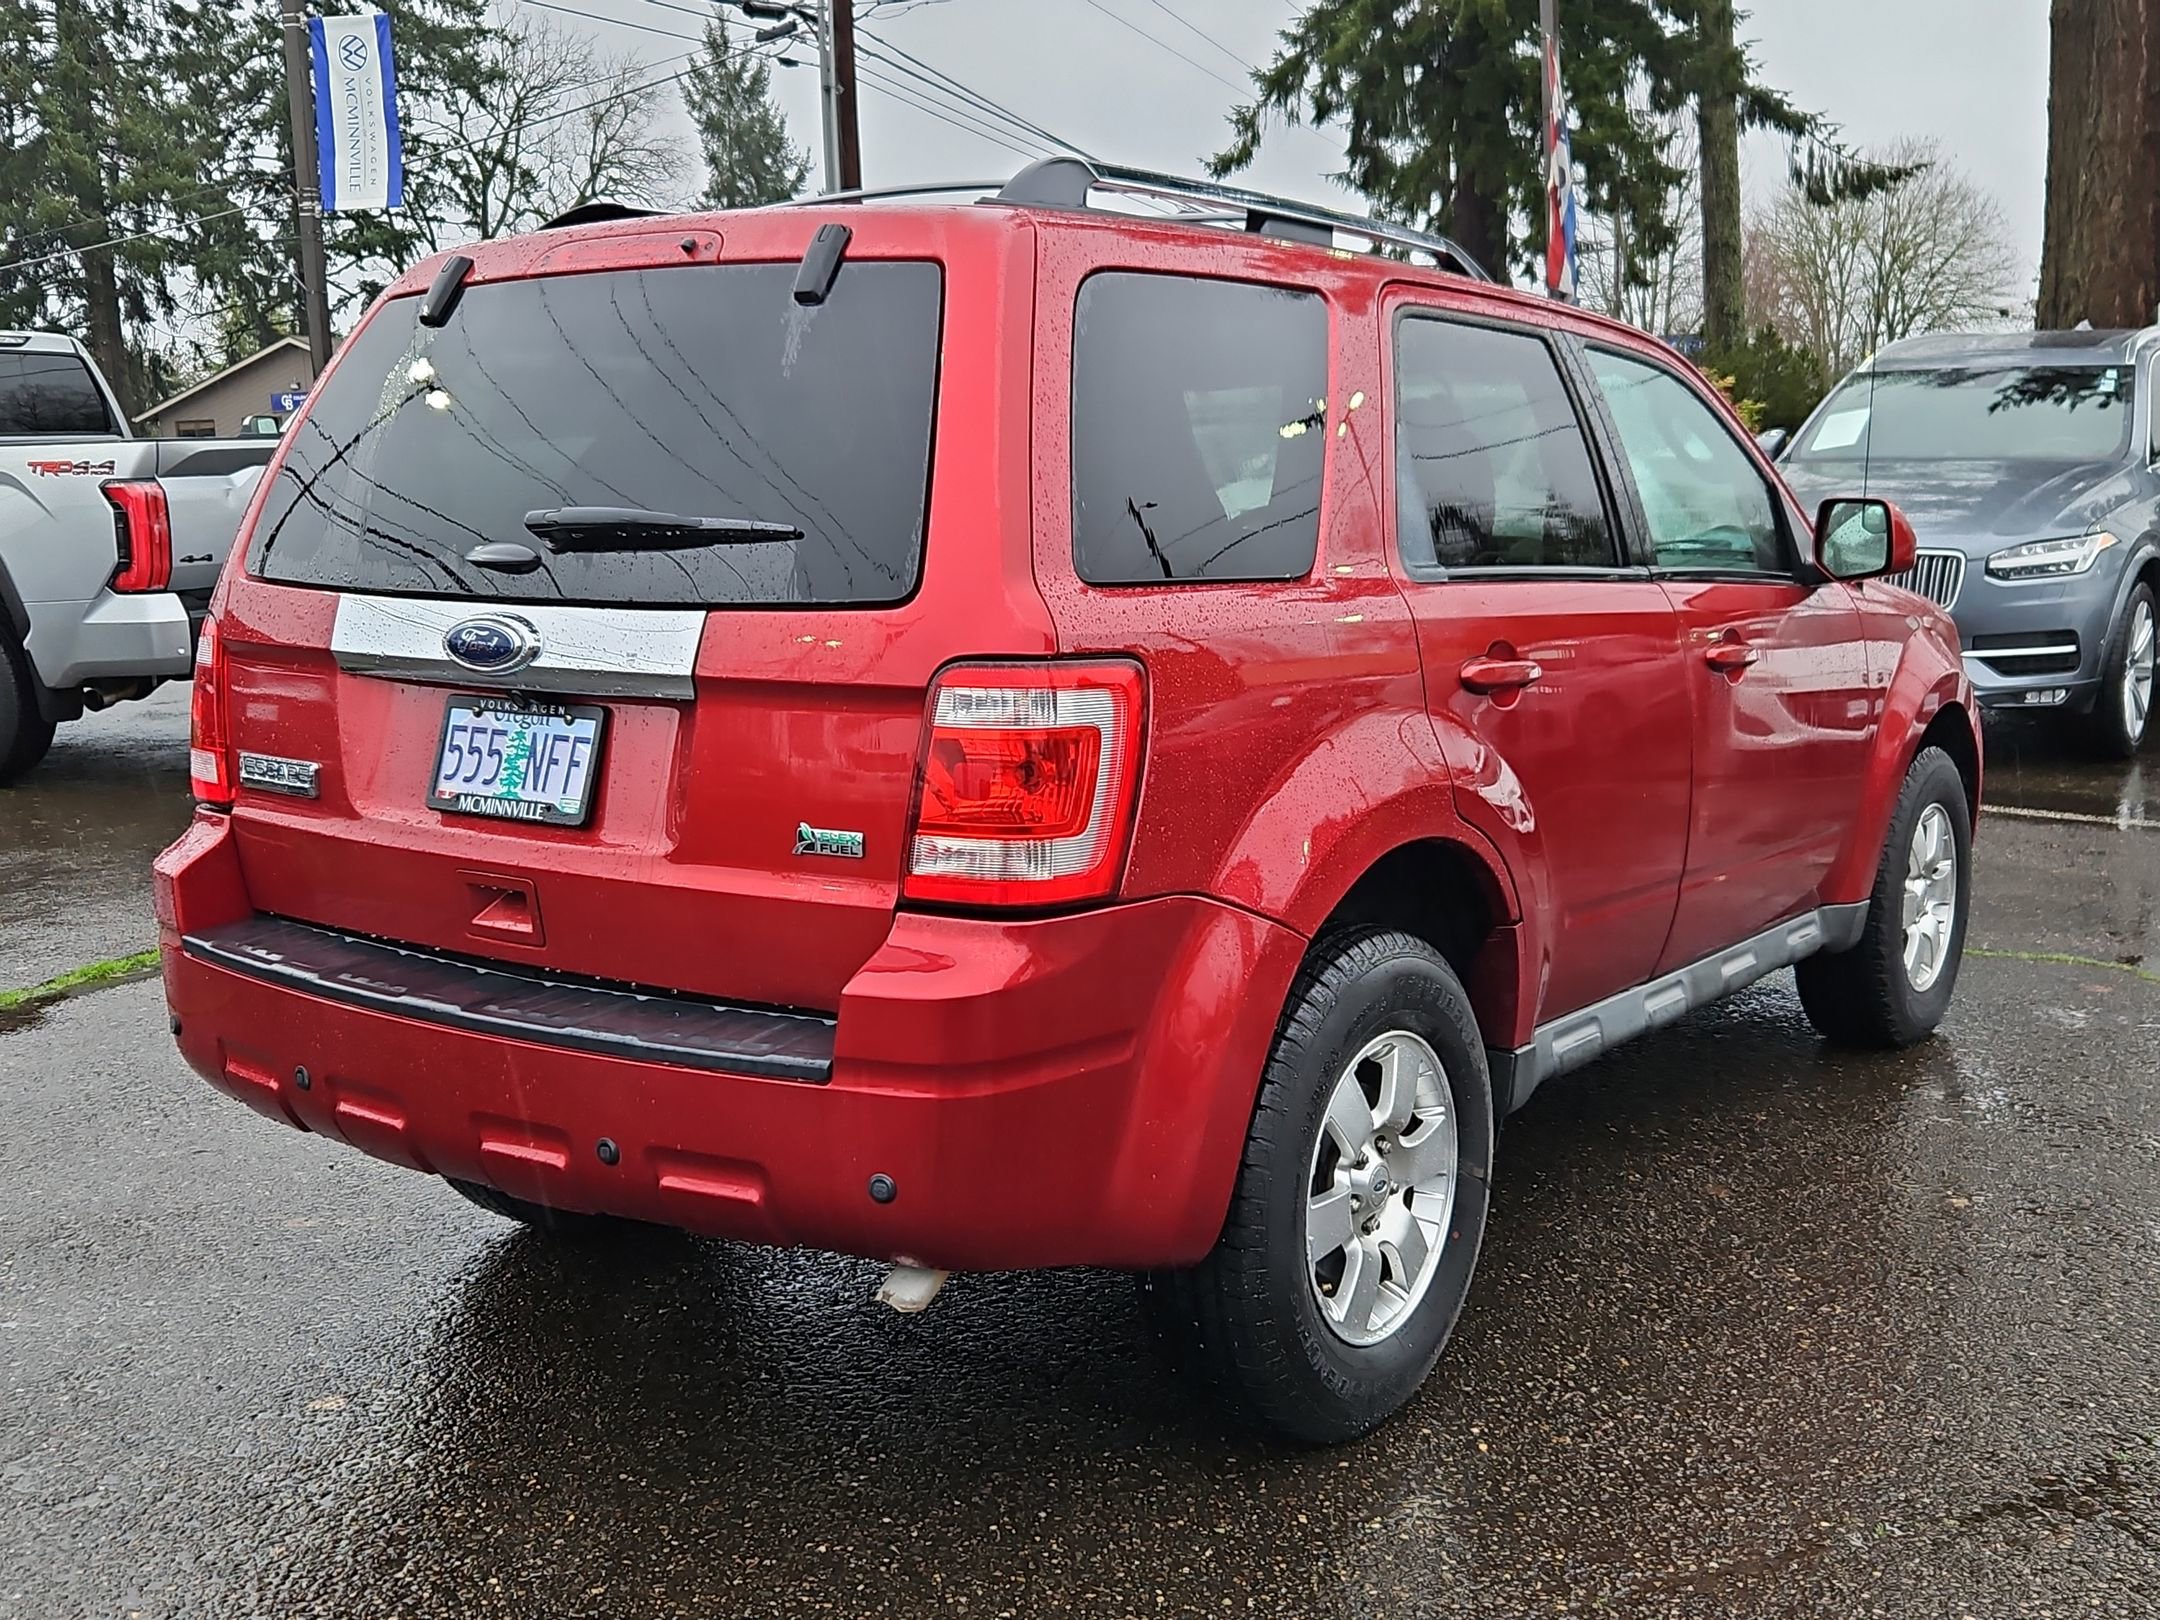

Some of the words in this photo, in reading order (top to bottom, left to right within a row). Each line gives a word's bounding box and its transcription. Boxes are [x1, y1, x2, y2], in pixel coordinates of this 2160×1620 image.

[344, 77, 362, 193] MCMINNVILLE
[364, 77, 378, 186] VOLKSWAGEN
[28, 460, 72, 478] TRD
[456, 627, 500, 654] Ford
[480, 699, 566, 716] VOLKSAGEN
[244, 756, 312, 785] ESCAPE
[442, 724, 508, 786] 555
[521, 731, 592, 795] NFF
[458, 794, 546, 820] MCMINNVILLE
[818, 831, 860, 845] FLEX
[820, 843, 860, 856] FUEL
